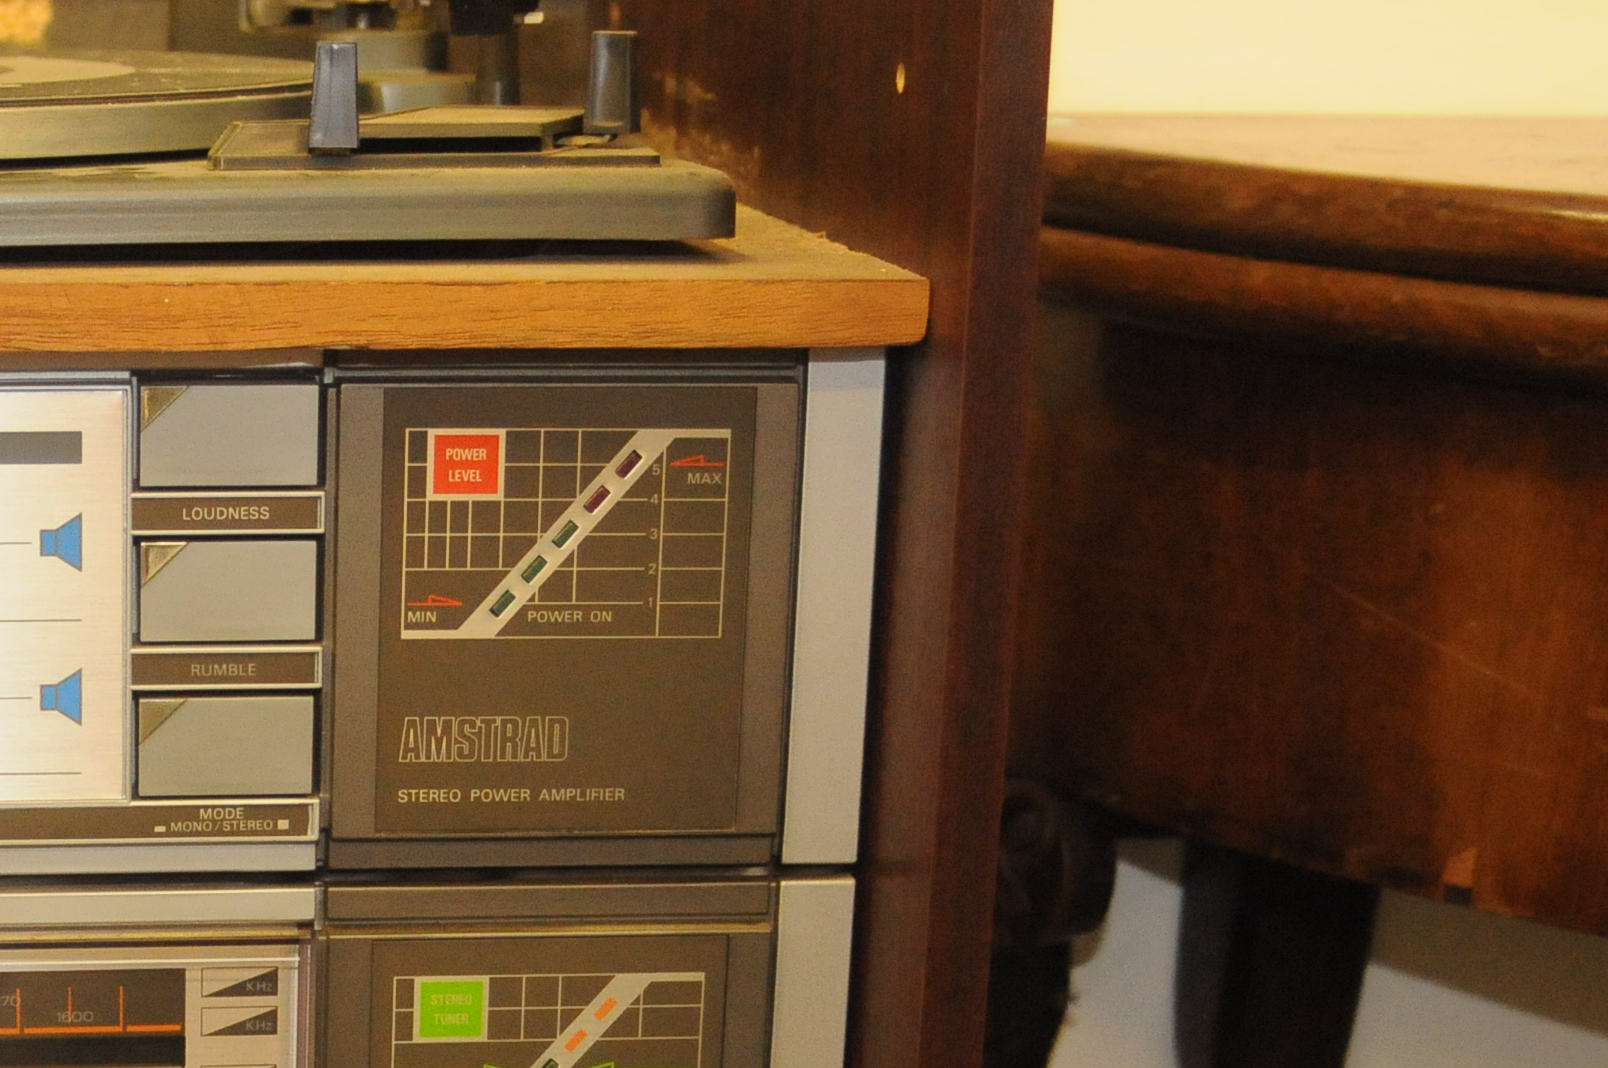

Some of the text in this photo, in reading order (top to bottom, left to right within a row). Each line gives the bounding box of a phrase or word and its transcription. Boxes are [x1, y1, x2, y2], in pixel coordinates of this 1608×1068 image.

[445, 448, 487, 461] POWER
[652, 464, 661, 475] 5
[449, 470, 482, 483] LEVEL
[687, 472, 722, 485] MAX
[650, 494, 658, 504] 4
[182, 505, 270, 522] LOUDNESS
[650, 529, 658, 539] 3
[648, 563, 656, 574] 2
[407, 611, 437, 623] MIN
[527, 610, 612, 623] POWER ON
[191, 661, 257, 677] RUMBLE
[398, 716, 569, 763] AMSTRAD
[397, 787, 625, 803] STEREO POWER AMPLIFIER
[199, 807, 244, 820] MODE
[431, 993, 472, 1006] STEREO
[246, 1020, 273, 1031] KHz
[434, 1013, 469, 1025] TUNER
